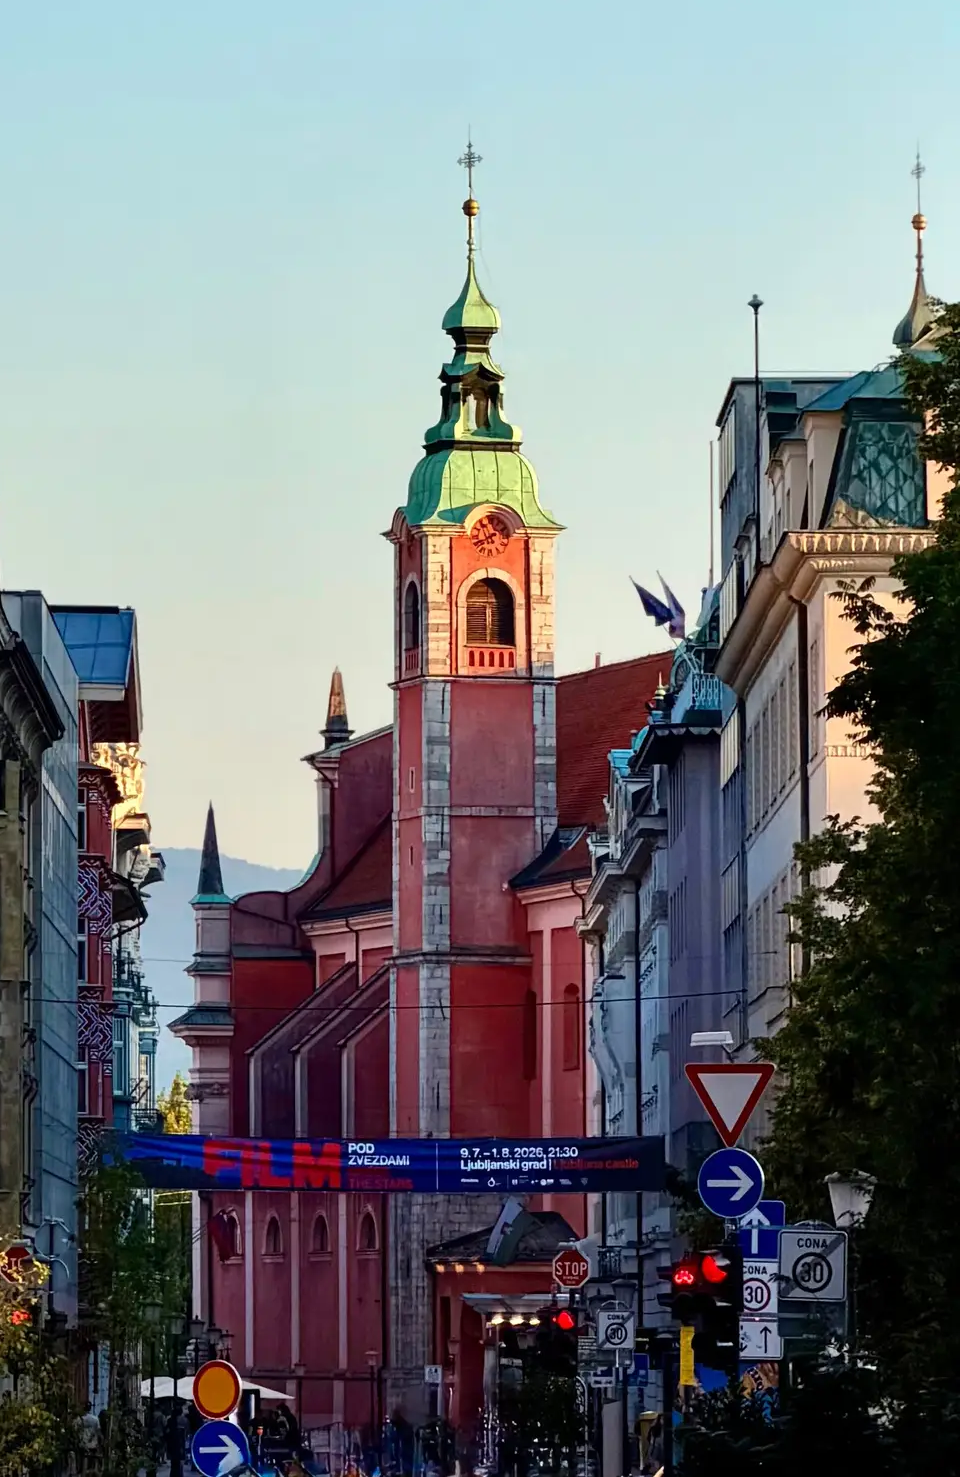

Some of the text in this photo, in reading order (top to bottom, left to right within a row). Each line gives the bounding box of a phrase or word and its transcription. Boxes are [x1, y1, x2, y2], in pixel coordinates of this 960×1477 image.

[348, 1143, 374, 1154] POD
[548, 1146, 578, 1158] 21:30
[203, 1141, 340, 1188] FILM
[348, 1155, 410, 1165] ZVEZDAMI
[460, 1159, 520, 1171] Ljubljanski
[521, 1159, 547, 1171] grad
[797, 1238, 828, 1249] CONA
[555, 1261, 588, 1276] STOP
[800, 1261, 824, 1283] 30
[744, 1286, 764, 1304] 30
[609, 1327, 623, 1340] 30
